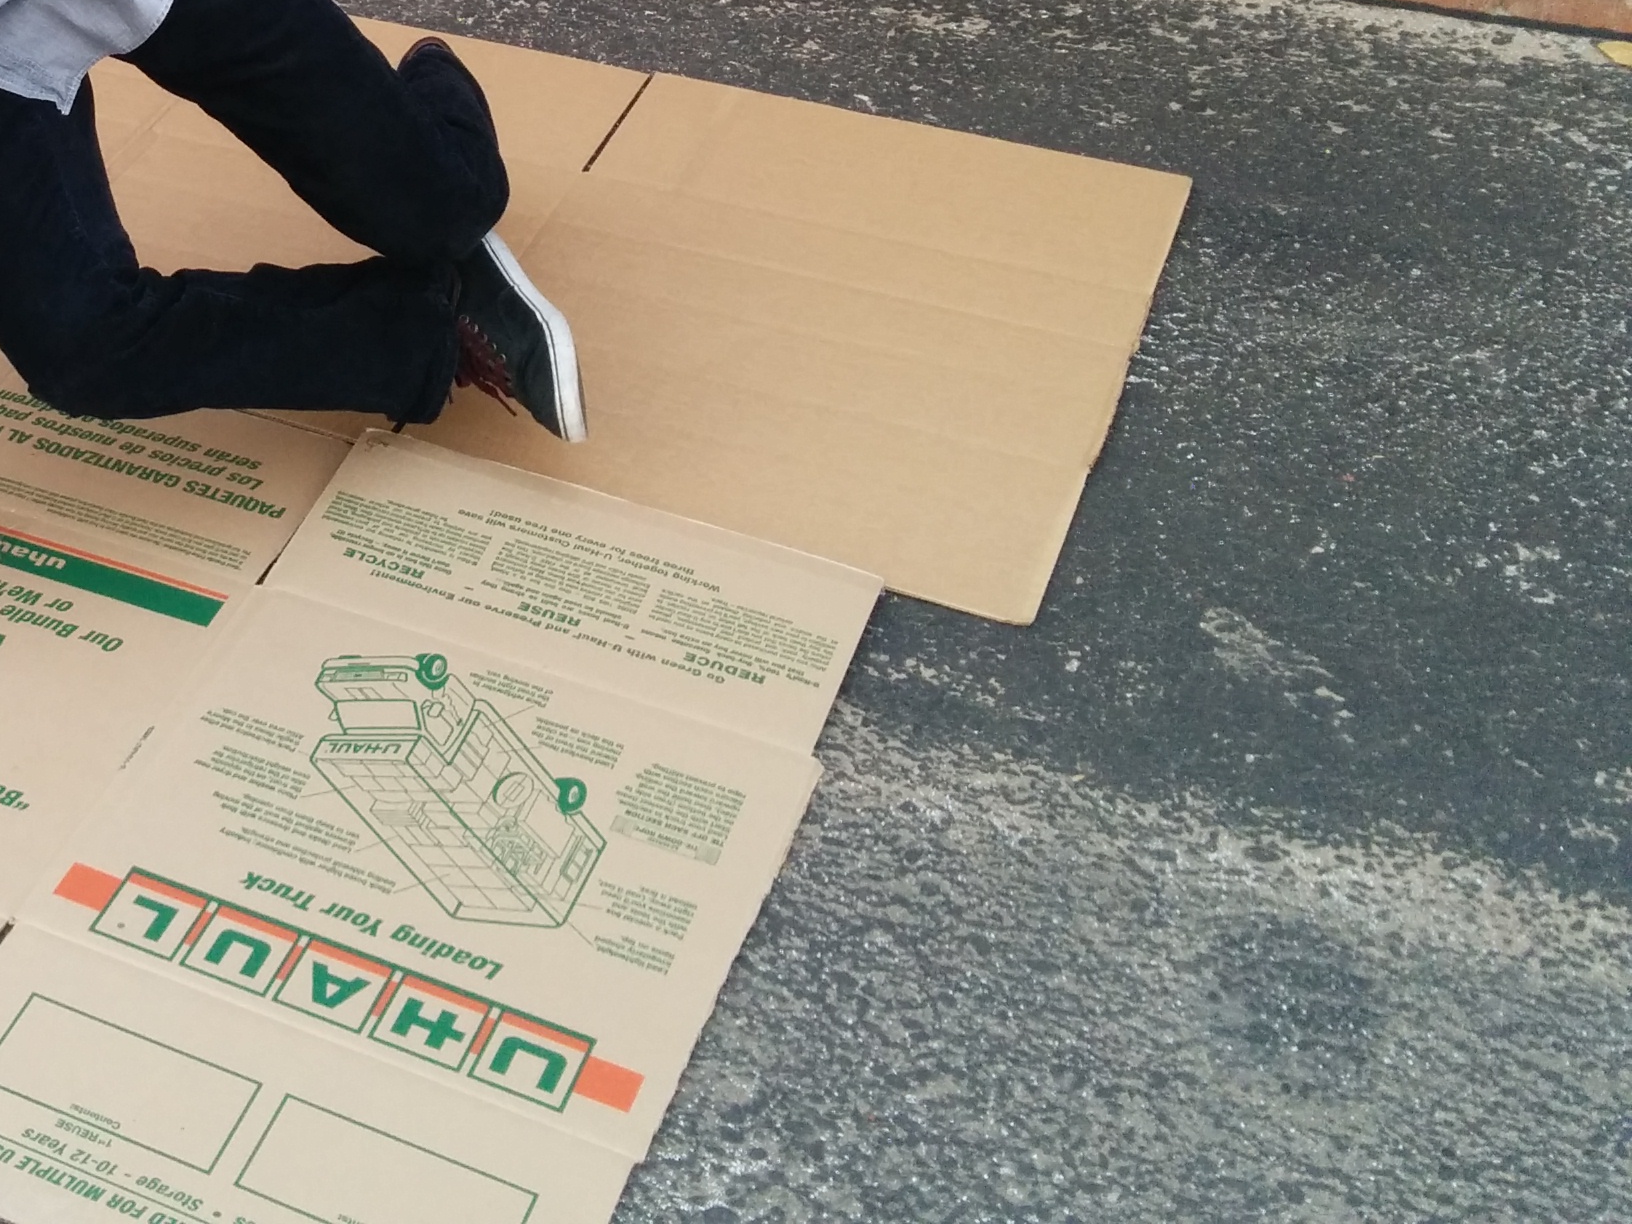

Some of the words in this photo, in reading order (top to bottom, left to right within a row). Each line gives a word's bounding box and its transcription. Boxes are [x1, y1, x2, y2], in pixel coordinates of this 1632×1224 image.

[0, 427, 34, 445] AL
[26, 415, 119, 449] nuestros
[93, 415, 205, 455] superados
[114, 439, 147, 457] de
[199, 446, 263, 473] serán
[29, 435, 184, 489] GARANTIZADOS
[144, 446, 227, 479] precios
[221, 470, 265, 491] Los
[179, 478, 288, 520] PAQUETES
[455, 507, 485, 521] save
[483, 516, 507, 528] will
[487, 508, 523, 524] used!
[522, 519, 549, 532] tree
[505, 523, 572, 548] Customers
[548, 527, 573, 539] one
[572, 533, 608, 549] every
[571, 543, 614, 560] U-Haul
[608, 544, 627, 556] for
[627, 550, 660, 565] trees
[339, 546, 427, 579] RECYCLE
[613, 554, 670, 577] together,
[660, 560, 695, 576] three
[367, 568, 457, 601] Environment!
[670, 571, 723, 592] Working
[41, 594, 76, 614] or
[456, 595, 482, 607] our
[481, 603, 543, 627] Preserve
[515, 600, 582, 627] REUSE
[75, 627, 125, 654] Our
[543, 622, 571, 635] and
[624, 647, 658, 663] with
[658, 657, 703, 677] Green
[680, 650, 767, 685] REDUCE
[704, 671, 726, 684] Go
[235, 869, 318, 912] Truck
[316, 898, 386, 937] Your
[386, 921, 504, 982] Loading
[17, 1125, 70, 1156] Years
[52, 1117, 101, 1143] REUSE
[66, 1145, 122, 1178] 10-12
[13, 1152, 109, 1202] MULTIPLE
[131, 1171, 207, 1212] Storage
[103, 1190, 150, 1220] FOR
